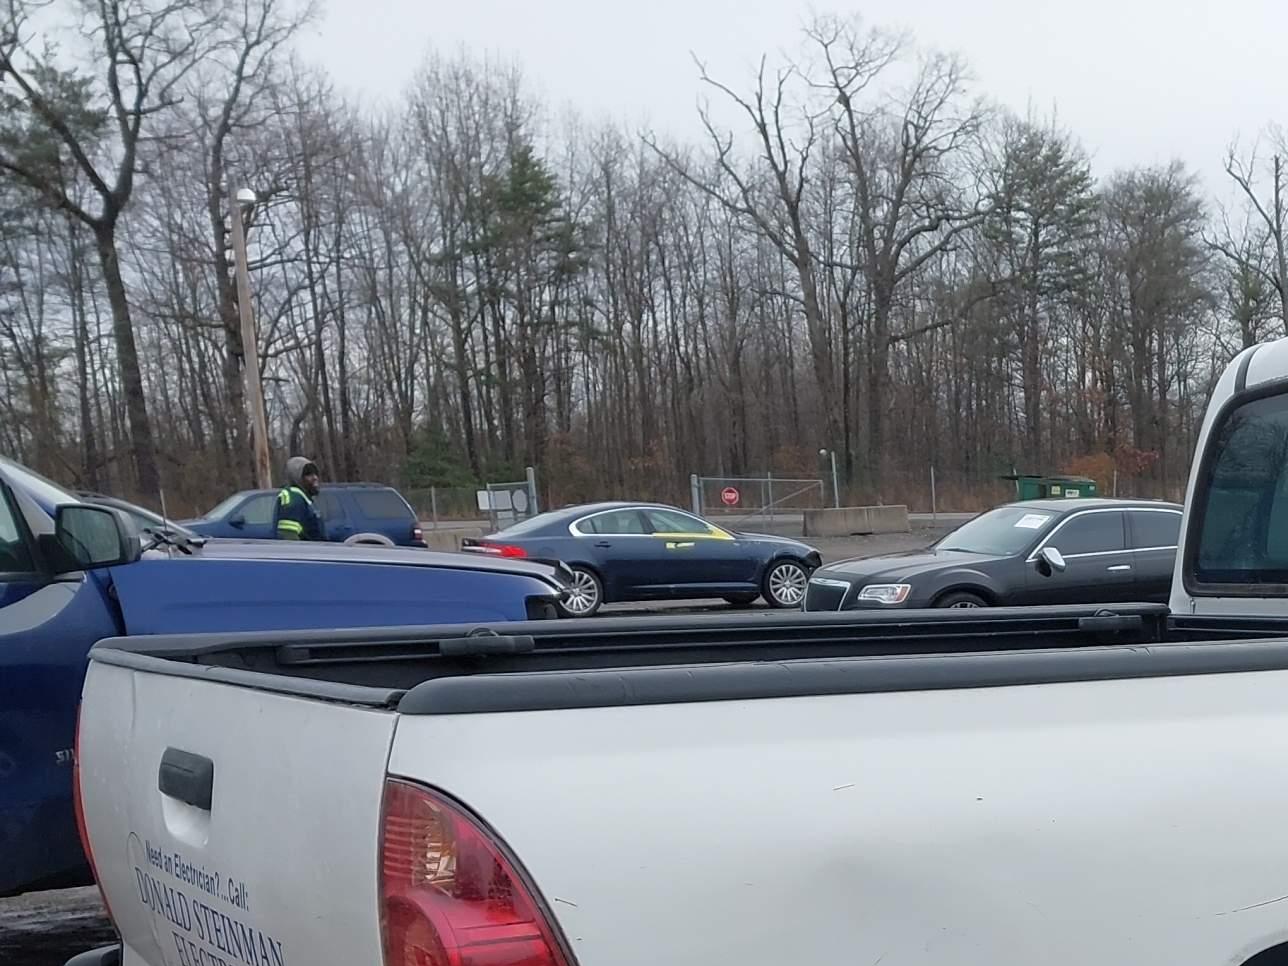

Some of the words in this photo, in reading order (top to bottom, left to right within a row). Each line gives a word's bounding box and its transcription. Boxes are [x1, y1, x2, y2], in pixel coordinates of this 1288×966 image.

[145, 839, 163, 870] Need
[163, 854, 173, 876] an
[134, 866, 192, 932] DONALD
